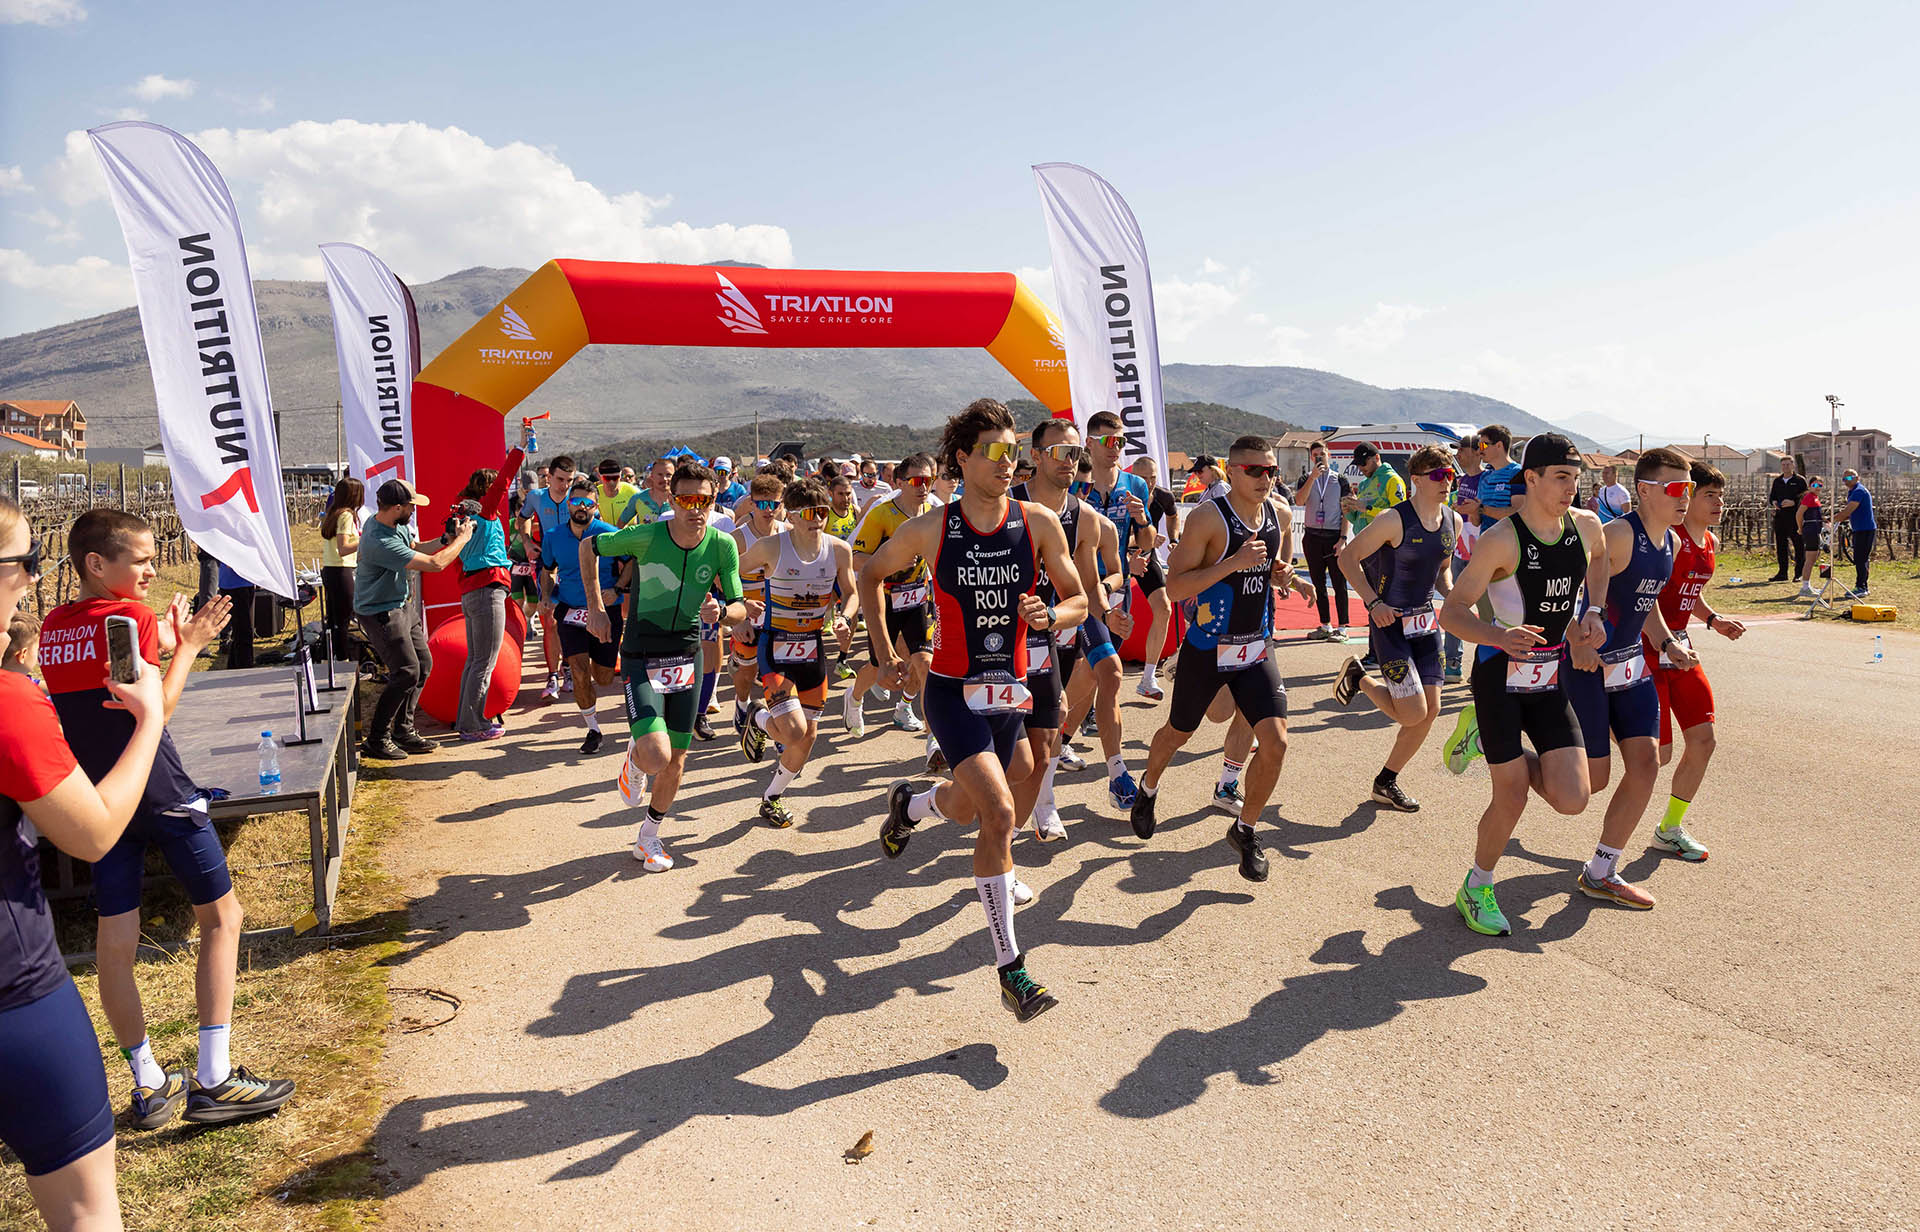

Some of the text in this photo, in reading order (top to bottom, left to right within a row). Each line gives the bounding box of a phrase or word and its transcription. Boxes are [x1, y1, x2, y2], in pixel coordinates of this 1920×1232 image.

[764, 294, 893, 313] TRIATLON
[770, 315, 809, 323] SAVEZ
[819, 316, 851, 324] CRNE
[478, 348, 553, 360] TRIATLON
[974, 548, 1012, 558] TRISPORT
[518, 566, 529, 574] 49
[957, 563, 1020, 586] REMZING
[1242, 577, 1264, 596] KOS
[1545, 576, 1572, 597] MORI
[902, 590, 918, 605] 24
[974, 589, 1008, 610] ROU
[1539, 600, 1570, 613] SLO
[1634, 597, 1653, 612] SRB
[976, 615, 1011, 629] ppc
[1413, 614, 1428, 631] 10
[38, 640, 97, 666] SERBIA
[785, 642, 806, 657] 75
[1237, 645, 1248, 662] 4
[660, 666, 685, 686] 52
[1530, 664, 1544, 684] 5
[1624, 661, 1632, 680] 6
[624, 682, 638, 720] NUTRITION
[984, 685, 1014, 705] 14
[1595, 848, 1614, 861] AVIC
[984, 882, 1007, 953] TRANSYLVANIA
